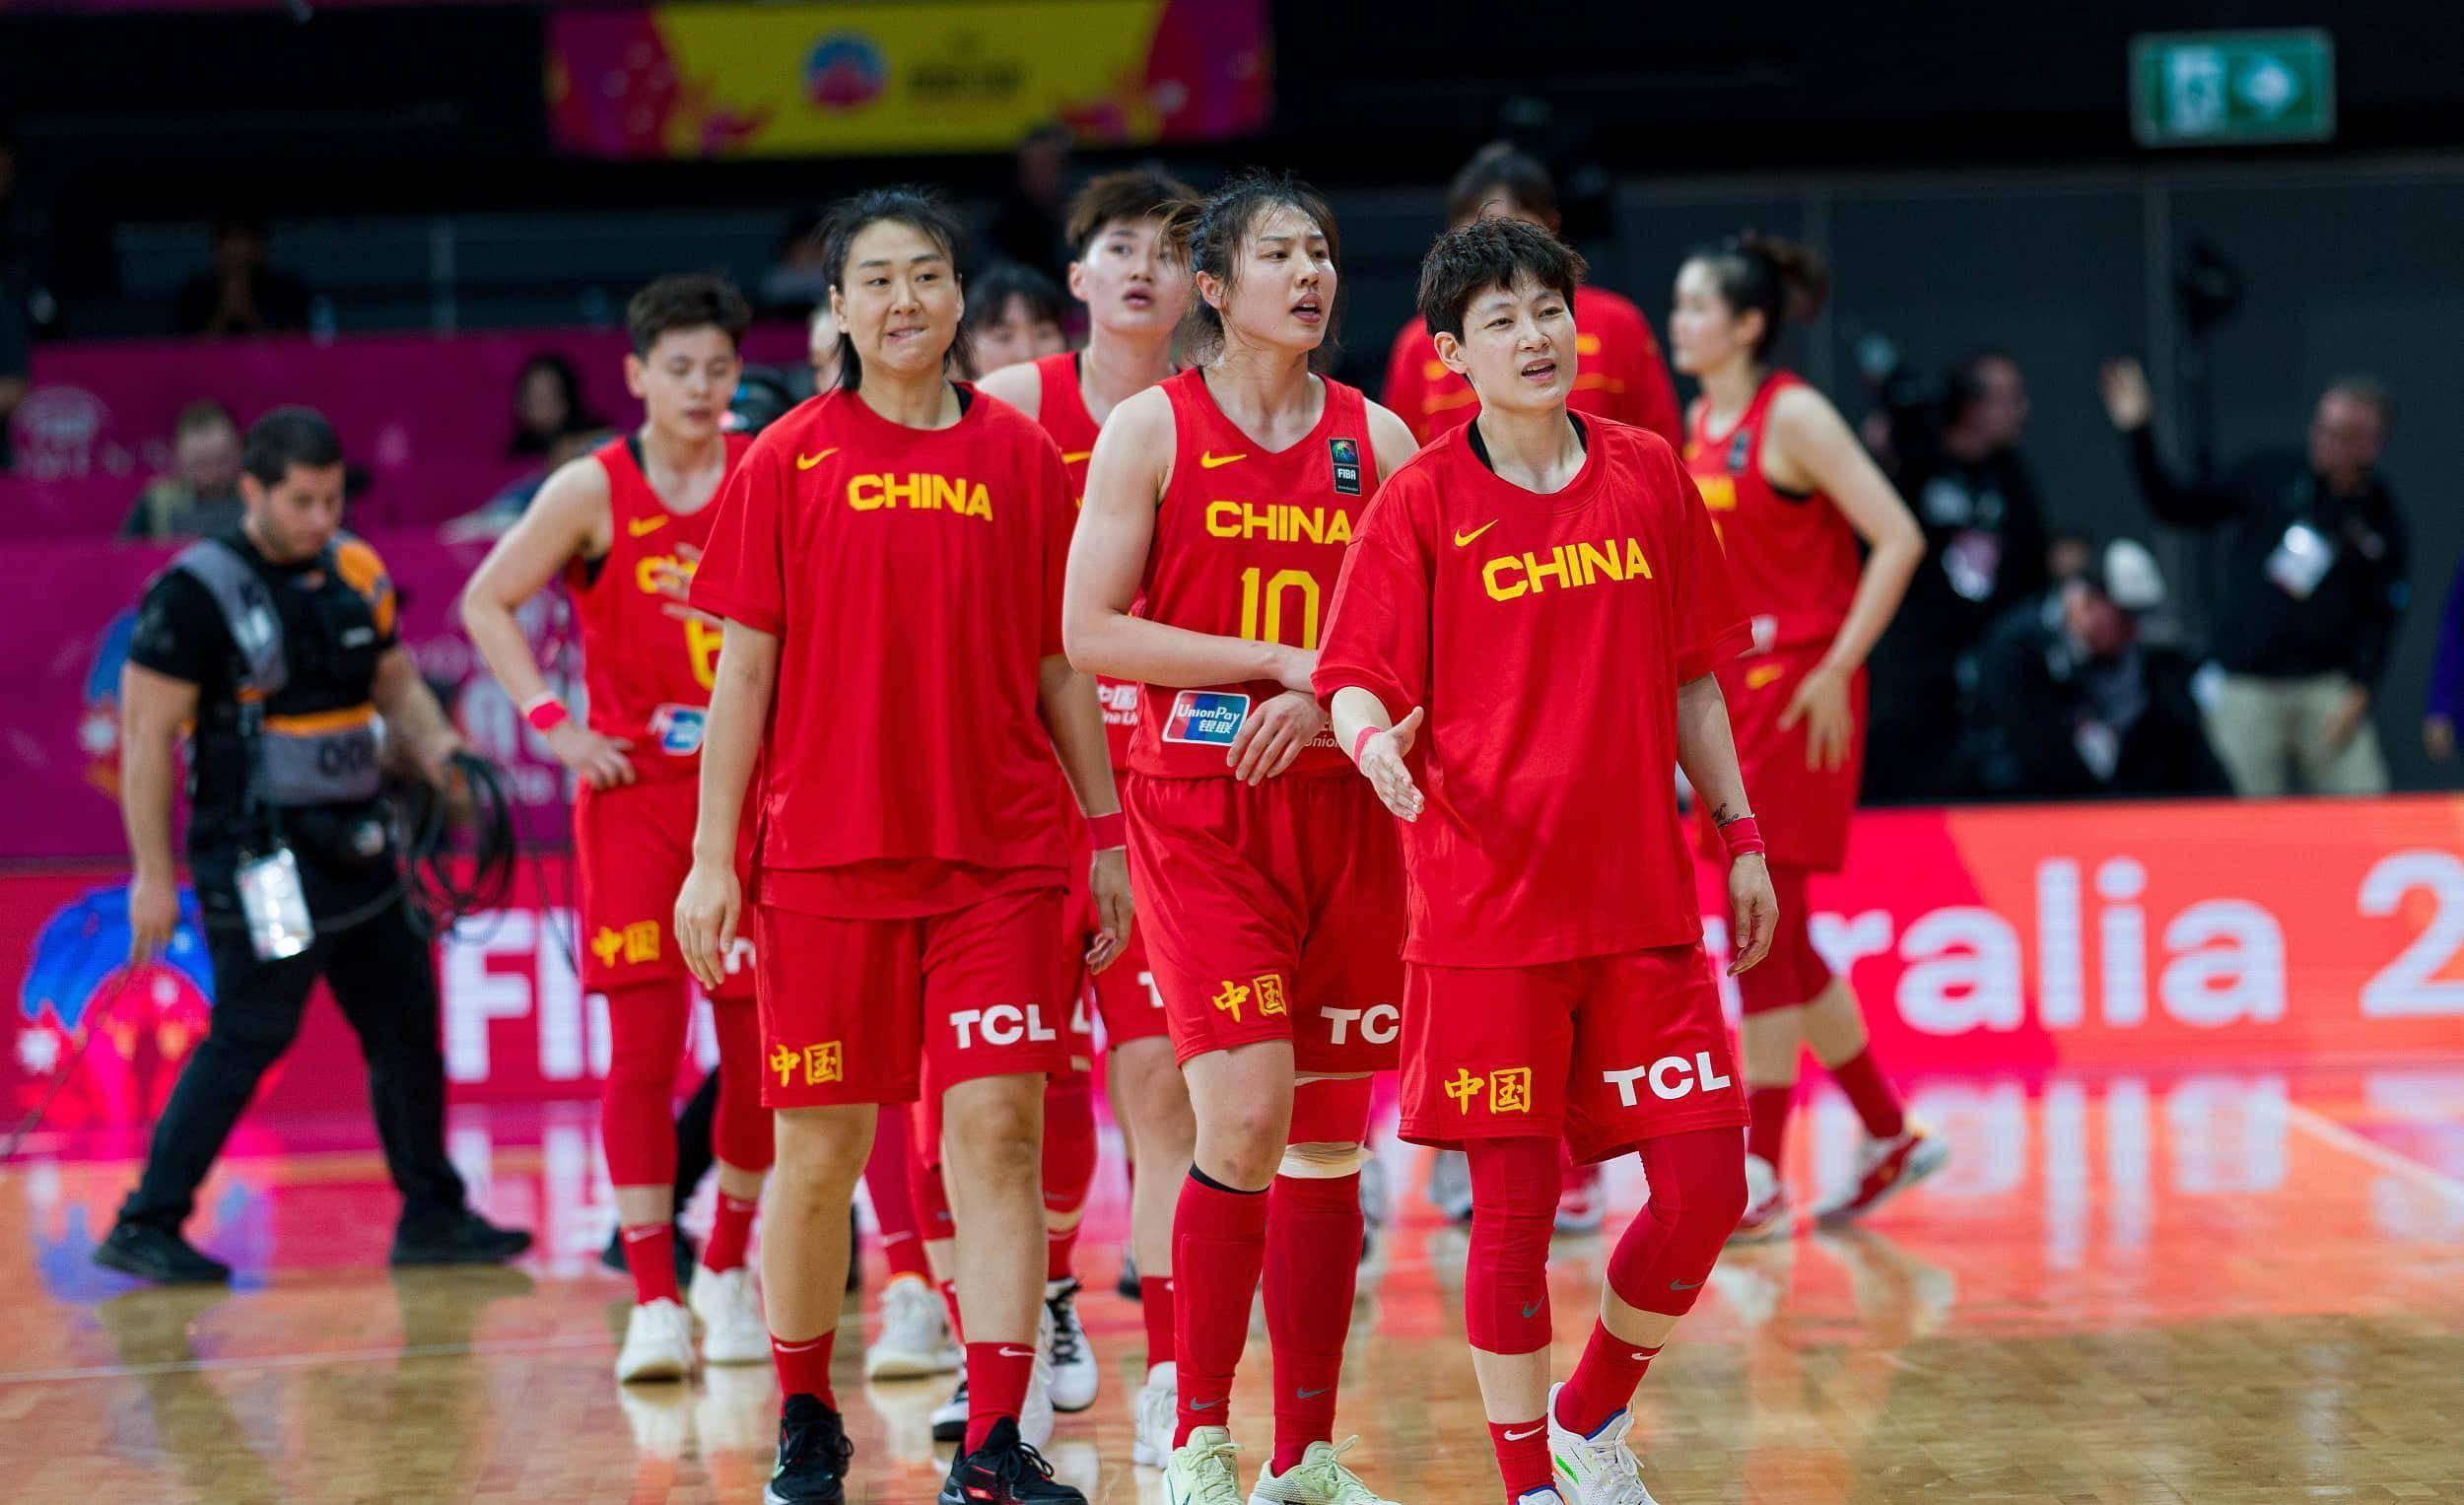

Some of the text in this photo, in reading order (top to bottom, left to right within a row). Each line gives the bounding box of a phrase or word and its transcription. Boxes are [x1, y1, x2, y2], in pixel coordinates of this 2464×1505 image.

[848, 473, 993, 521] CHINA
[1337, 468, 1356, 481] FIBA
[1205, 500, 1353, 545] CHINA
[1481, 537, 1653, 602] CHINA
[1239, 567, 1321, 650] 10
[1177, 704, 1241, 727] UnionPay
[1198, 718, 1232, 734] 银联
[592, 921, 660, 968] 中国
[443, 906, 613, 1083] FI
[1211, 974, 1288, 1023] 中国
[949, 1003, 1057, 1050] TCL
[1321, 1003, 1401, 1045] TC
[770, 1039, 843, 1088] 中国
[1603, 1051, 1731, 1107] TCL
[1444, 1066, 1533, 1116] 中国
